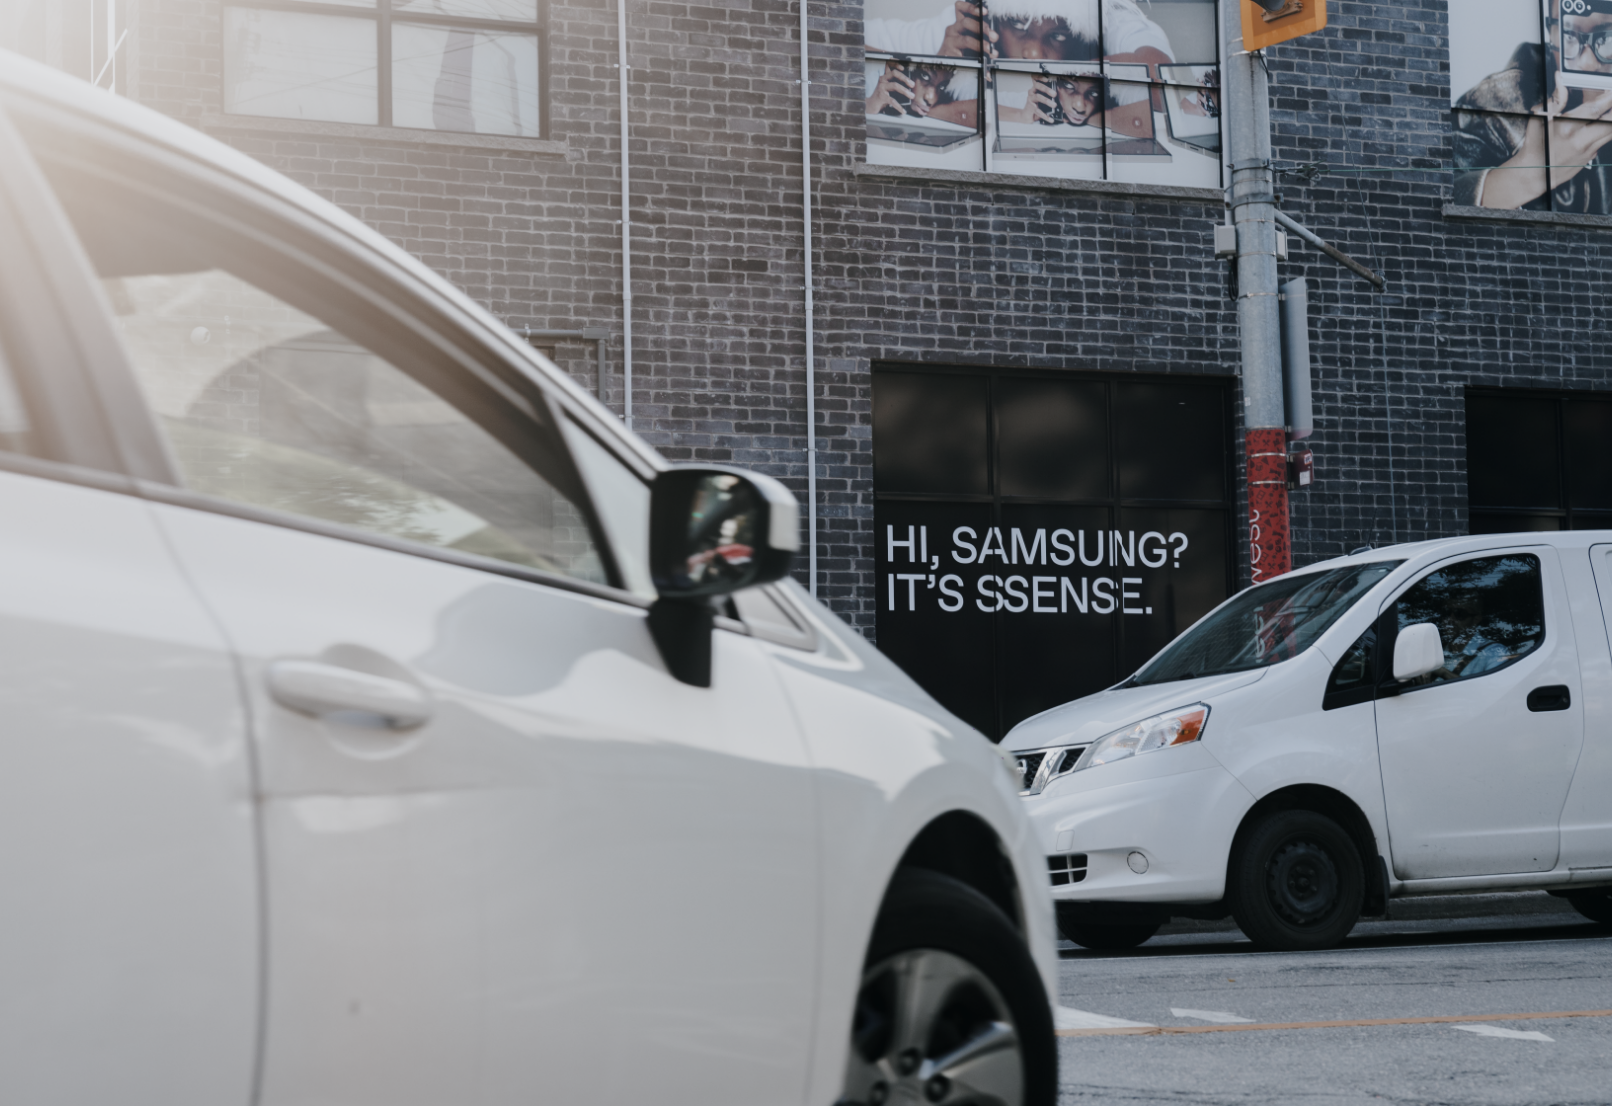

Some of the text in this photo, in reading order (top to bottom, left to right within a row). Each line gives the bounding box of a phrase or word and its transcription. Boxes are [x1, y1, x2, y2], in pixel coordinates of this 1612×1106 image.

[887, 524, 1189, 571] HI, SAMSUNG?
[887, 573, 1153, 615] IT'S SSENSE.
